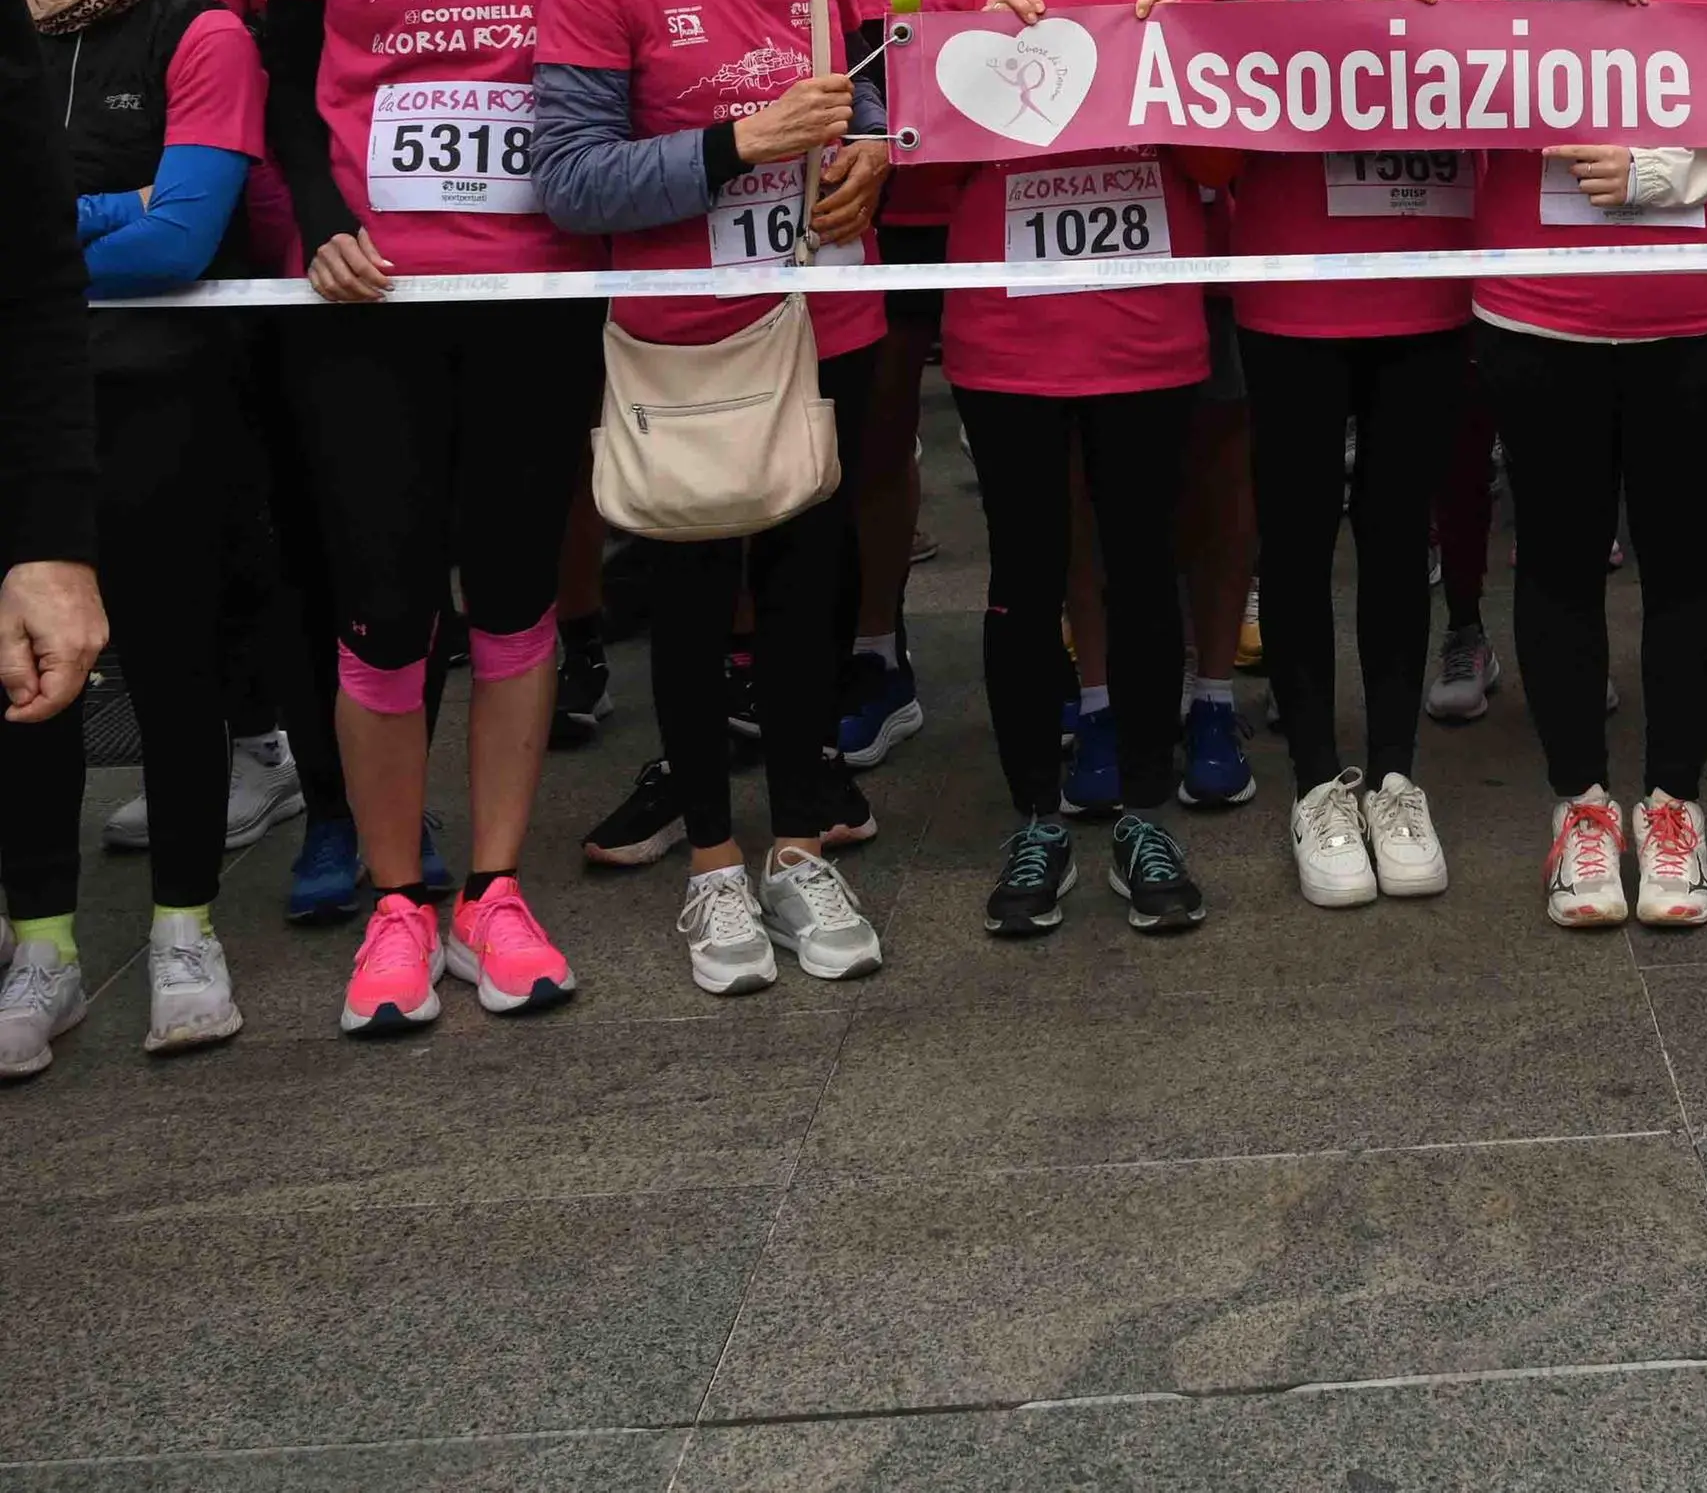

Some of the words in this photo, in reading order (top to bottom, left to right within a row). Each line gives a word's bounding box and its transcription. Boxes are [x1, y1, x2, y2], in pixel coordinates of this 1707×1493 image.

[422, 6, 533, 22] COTONELLA
[372, 34, 384, 55] la
[384, 29, 467, 55] CORSA
[1017, 41, 1049, 56] Cuore
[1128, 19, 1691, 132] Associazione
[378, 92, 394, 113] la
[397, 92, 480, 112] CORSA
[487, 89, 536, 113] ROS
[392, 124, 532, 175] 5318
[457, 182, 488, 192] UISP
[1024, 174, 1097, 199] CORSA
[1401, 188, 1427, 198] UISP
[1026, 204, 1150, 259] 1028
